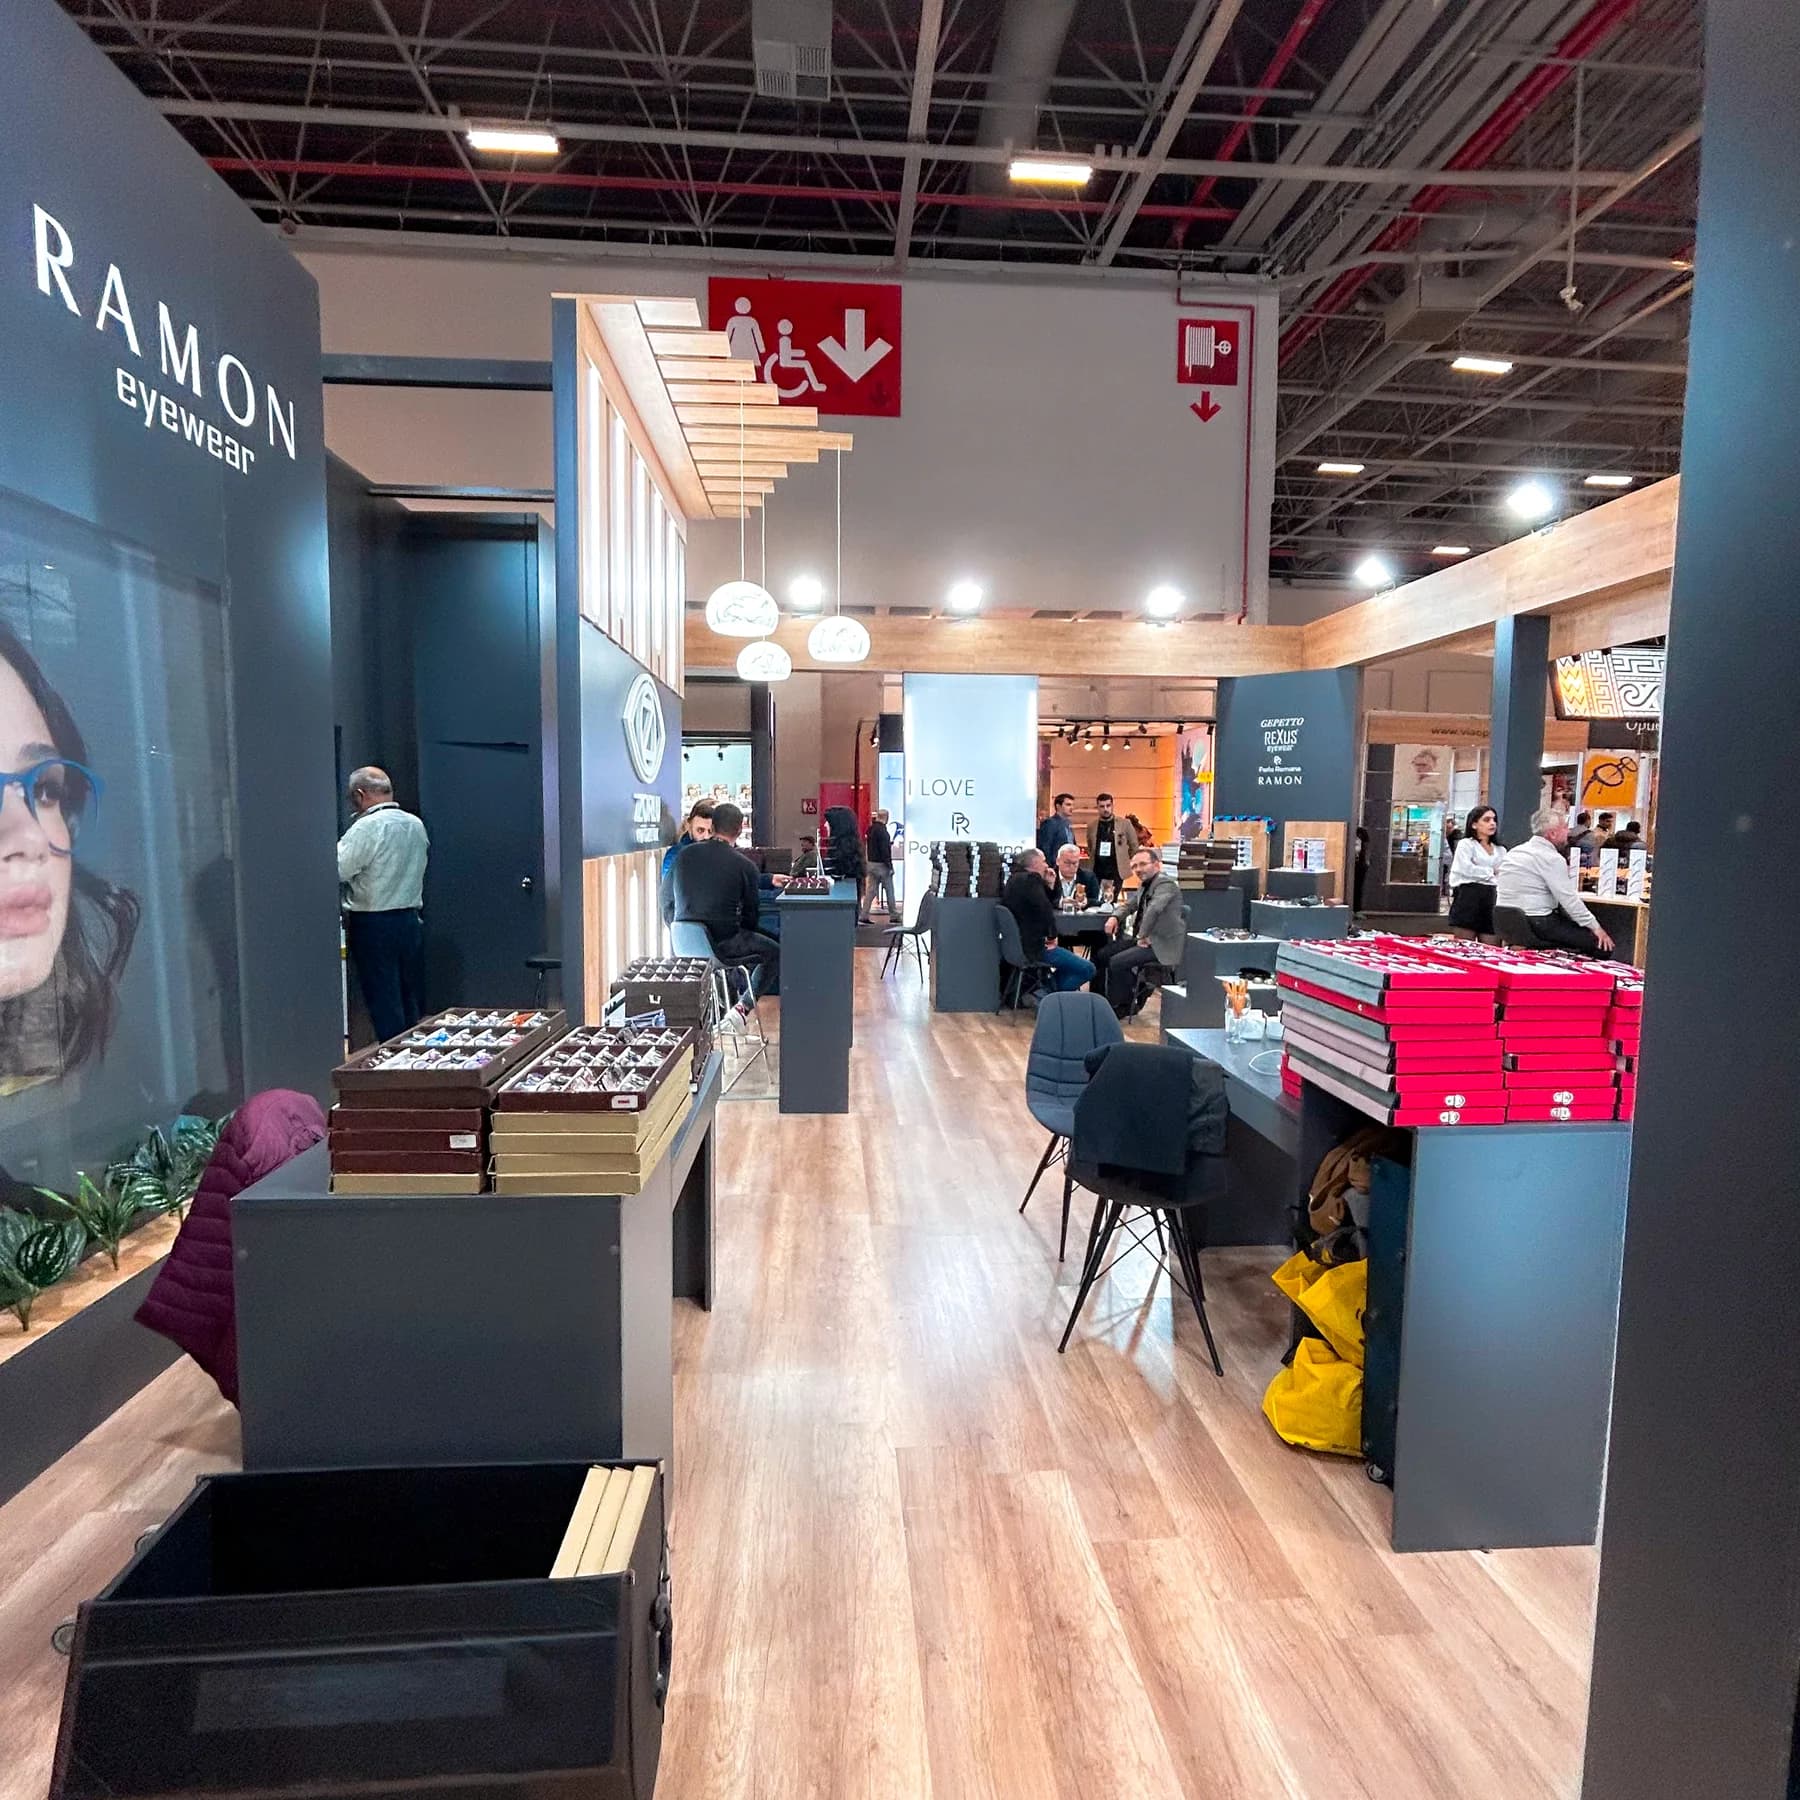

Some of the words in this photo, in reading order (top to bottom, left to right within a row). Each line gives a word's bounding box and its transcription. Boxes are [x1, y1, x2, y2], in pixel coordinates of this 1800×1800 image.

[33, 203, 296, 460] RAMON
[116, 367, 255, 475] eyewear
[1260, 717, 1304, 728] GEPETTO
[1264, 729, 1298, 745] REXUS
[907, 779, 912, 796] I
[921, 779, 975, 796] LOVE
[1258, 775, 1303, 785] RAMON
